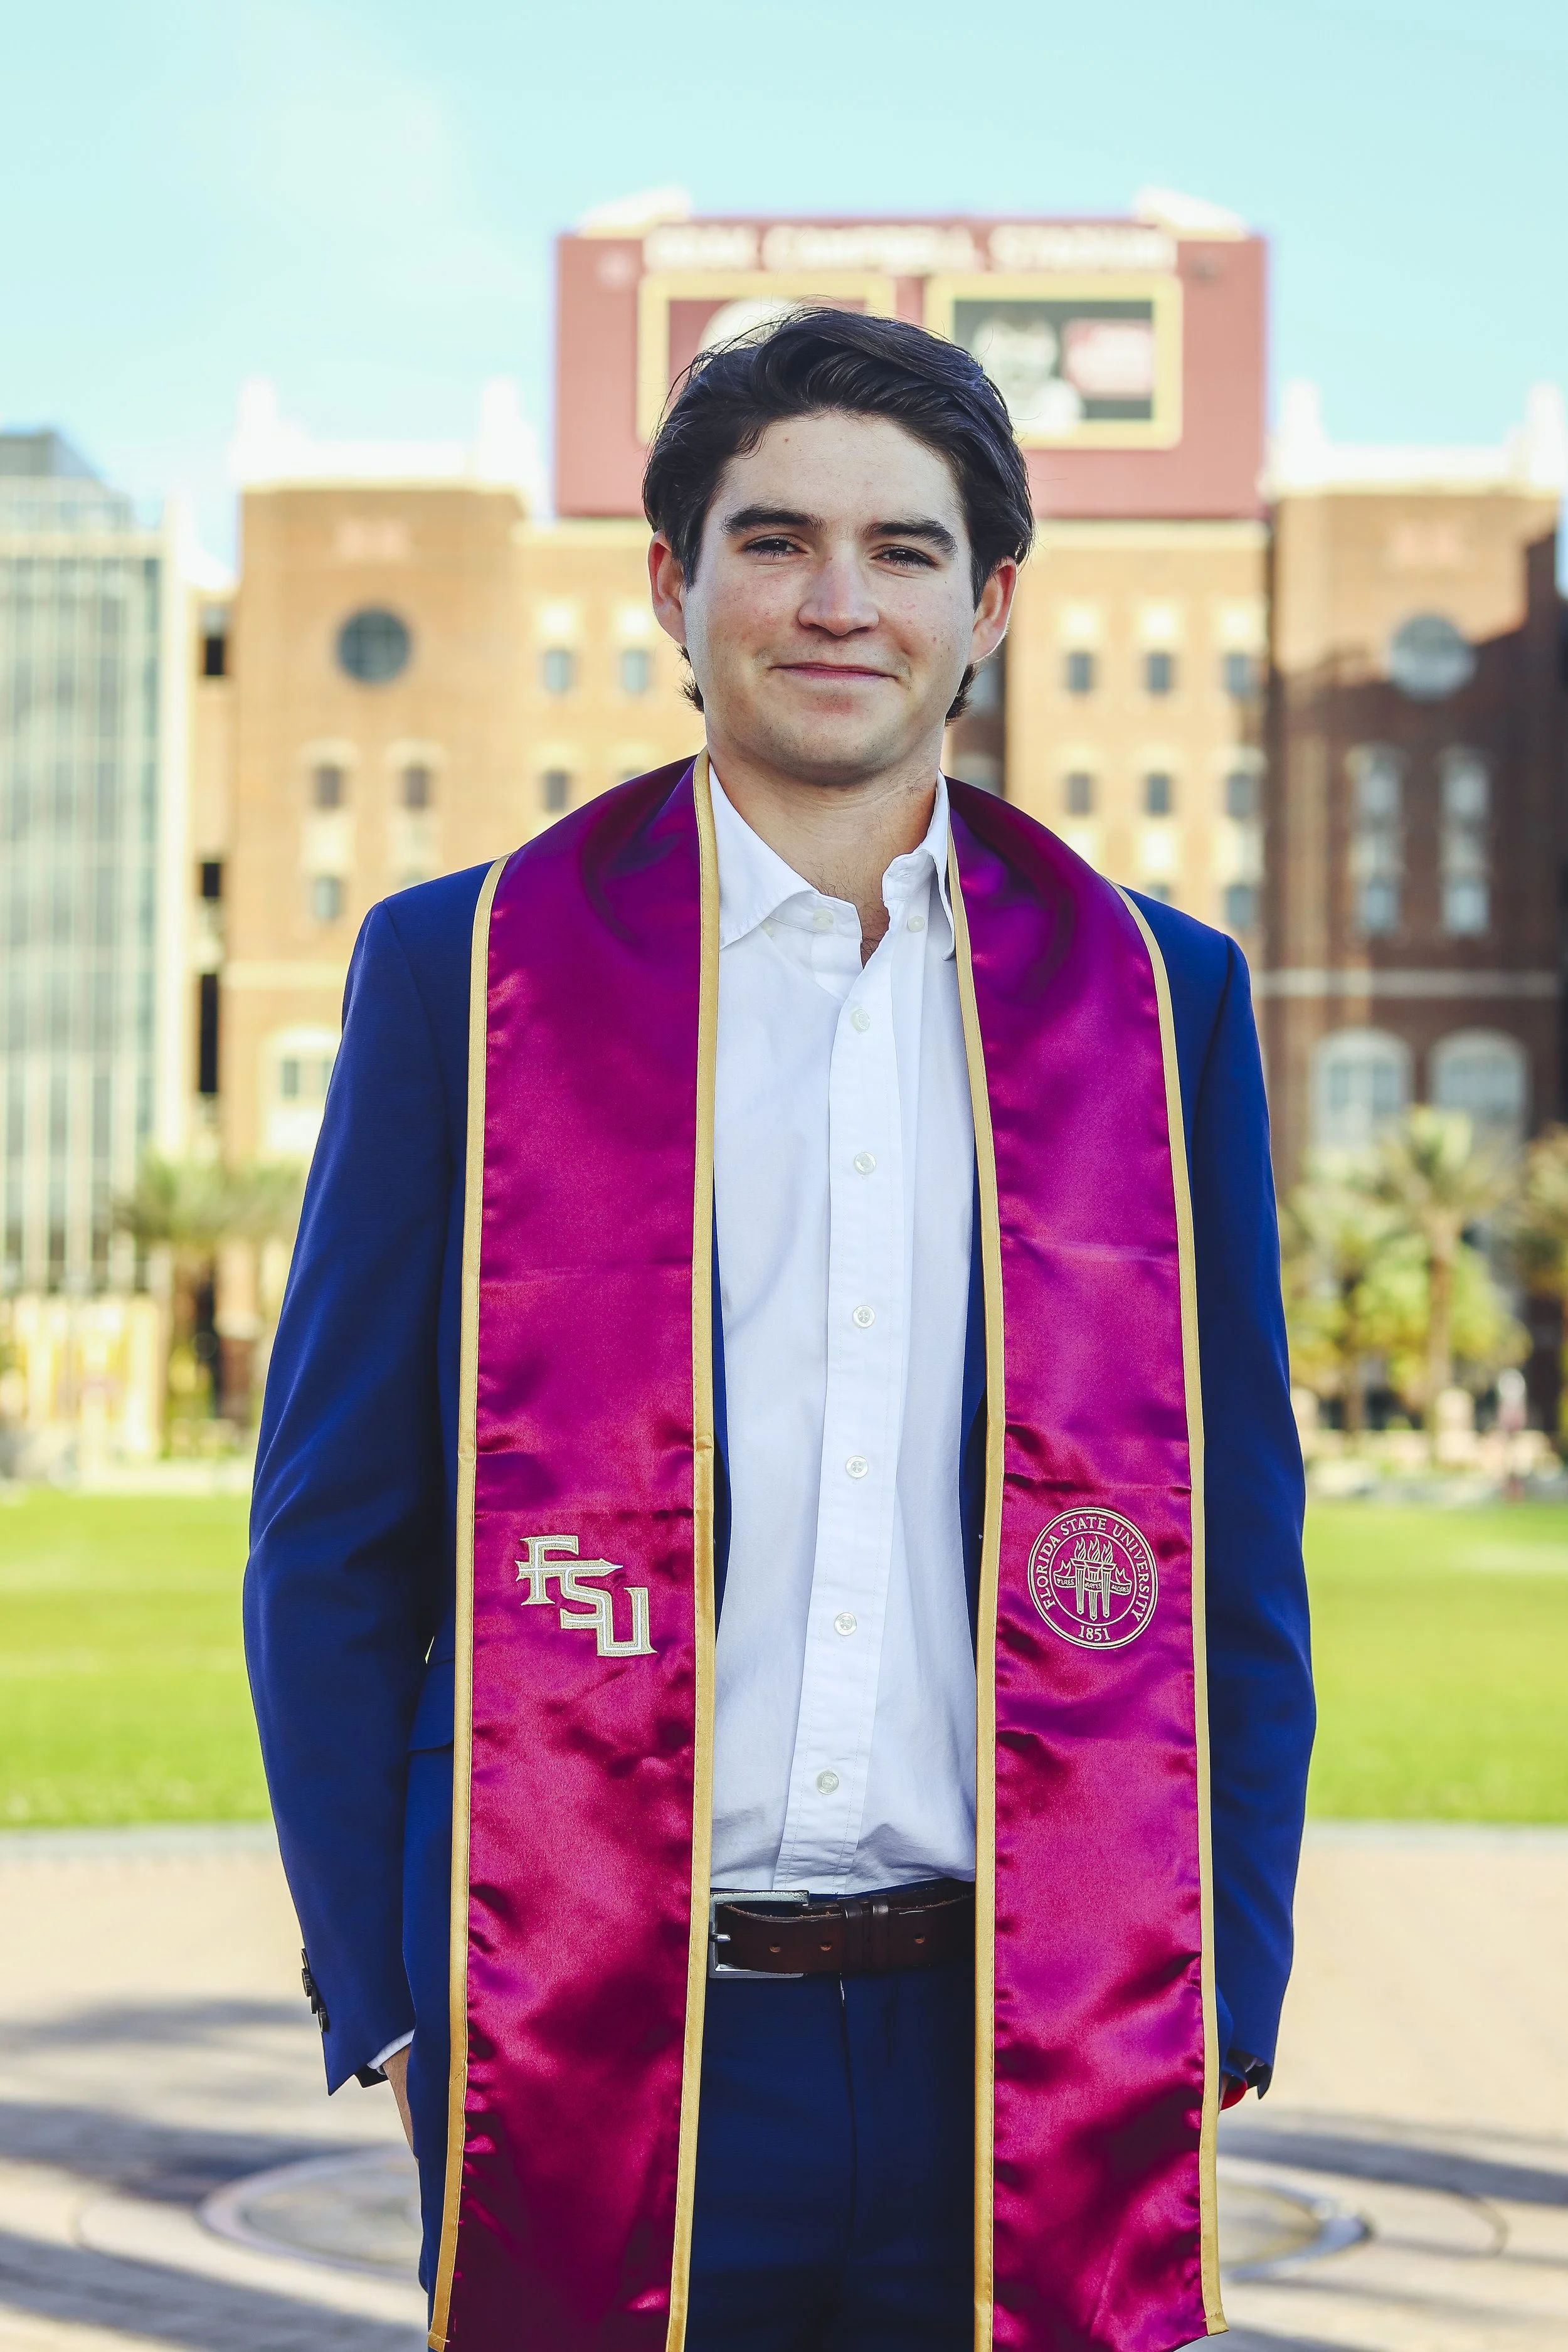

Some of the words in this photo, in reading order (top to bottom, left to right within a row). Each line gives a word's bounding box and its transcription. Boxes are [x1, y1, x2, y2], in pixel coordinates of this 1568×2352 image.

[515, 1535, 657, 1656] FSU
[1036, 1535, 1061, 1610] FLORIDA
[1060, 1516, 1107, 1536] STATE
[1112, 1523, 1150, 1622] UNIVERSITY
[1078, 1625, 1111, 1642] 1851
